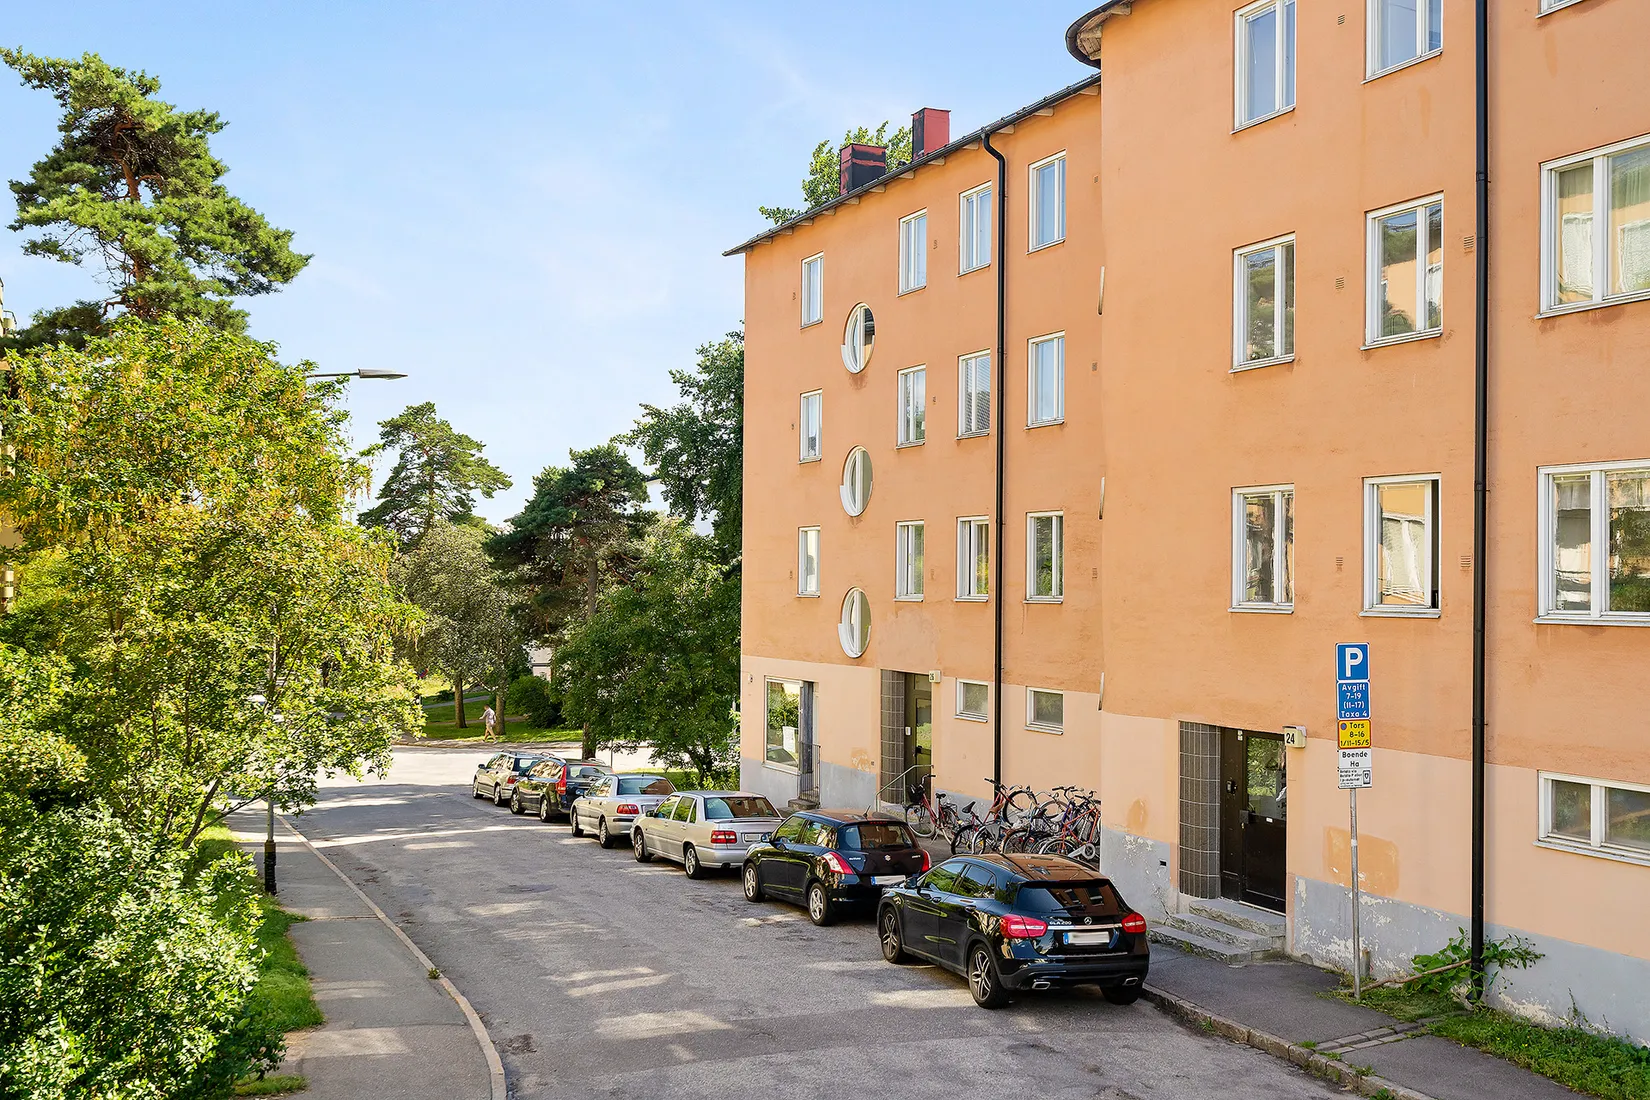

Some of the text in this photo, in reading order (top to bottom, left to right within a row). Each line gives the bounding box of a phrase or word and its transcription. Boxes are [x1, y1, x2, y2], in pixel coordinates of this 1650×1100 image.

[1345, 647, 1363, 677] P
[1342, 684, 1366, 692] Avgift
[1346, 692, 1362, 700] 7-19
[1343, 701, 1365, 709] (11-17)
[1341, 710, 1360, 718] Taxa
[1286, 732, 1295, 744] 24
[1340, 739, 1370, 747] 1/11-15/5
[1349, 760, 1360, 768] Ha
